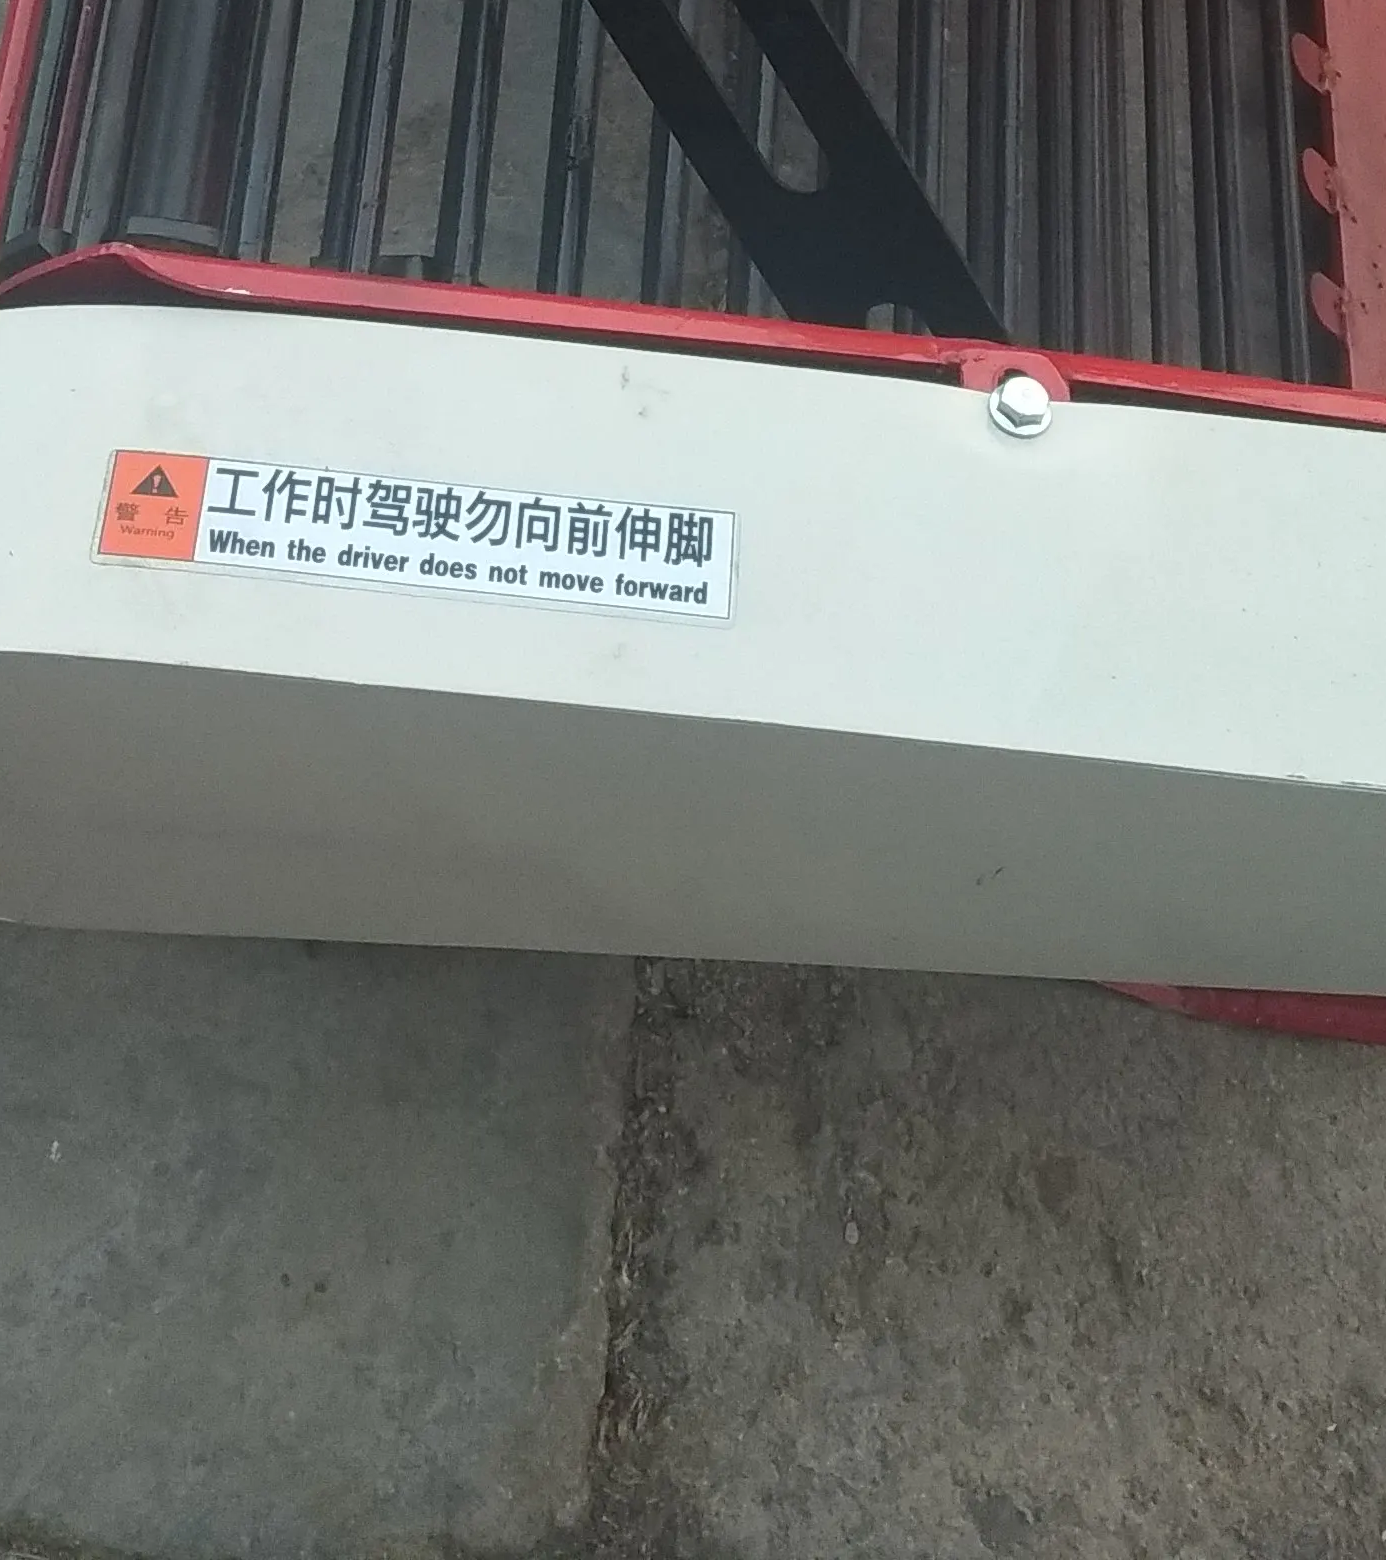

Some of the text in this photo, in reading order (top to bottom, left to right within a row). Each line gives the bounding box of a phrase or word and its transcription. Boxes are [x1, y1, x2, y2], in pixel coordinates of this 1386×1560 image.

[116, 502, 189, 526] 警告
[120, 523, 175, 540] Warning
[207, 467, 714, 567] 工作时驾驶勿向前伸脚
[209, 528, 708, 604] When the driver does not move forward
